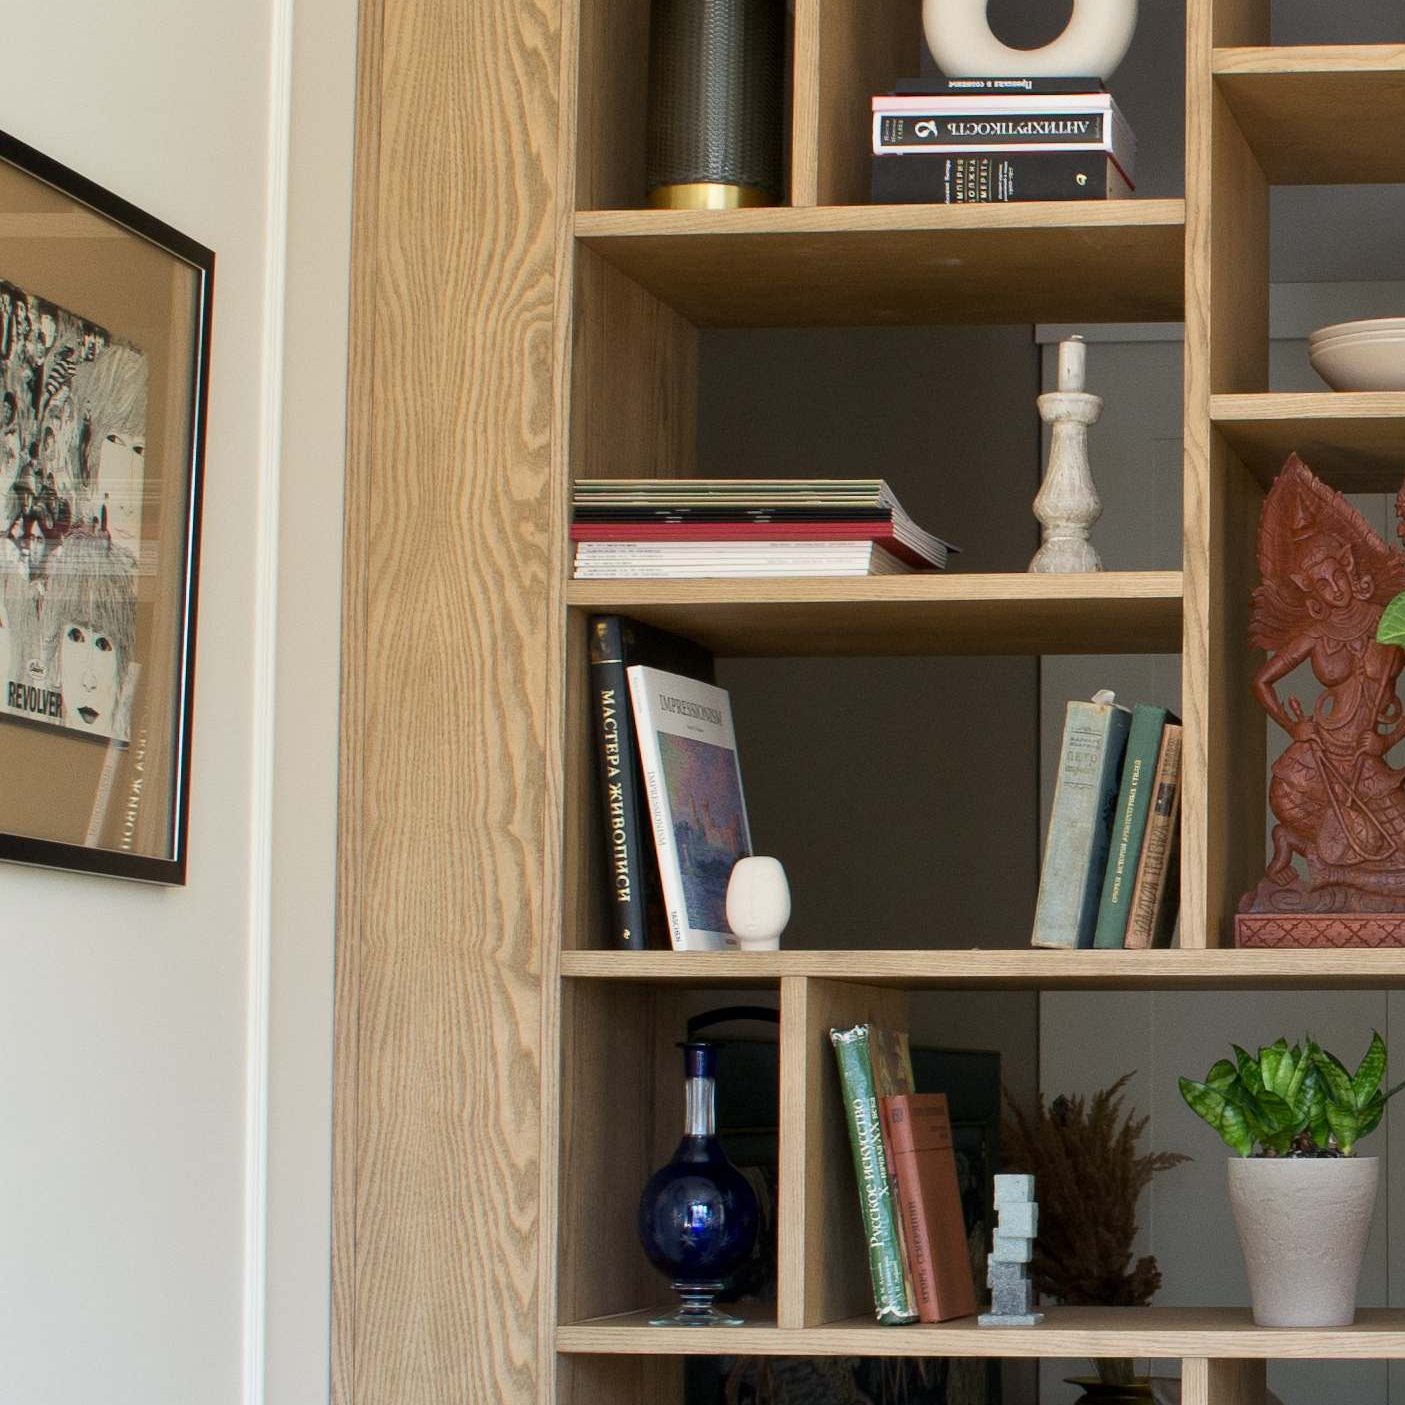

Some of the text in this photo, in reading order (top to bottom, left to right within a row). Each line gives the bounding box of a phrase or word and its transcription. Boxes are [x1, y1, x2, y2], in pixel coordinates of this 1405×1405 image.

[946, 120, 1090, 136] АНТИХРУПКОСТЬ
[8, 681, 63, 719] REVOLVER
[599, 689, 632, 903] МАСТЕРА ЖИВОПИСИ
[852, 1098, 885, 1248] Русское искусство
